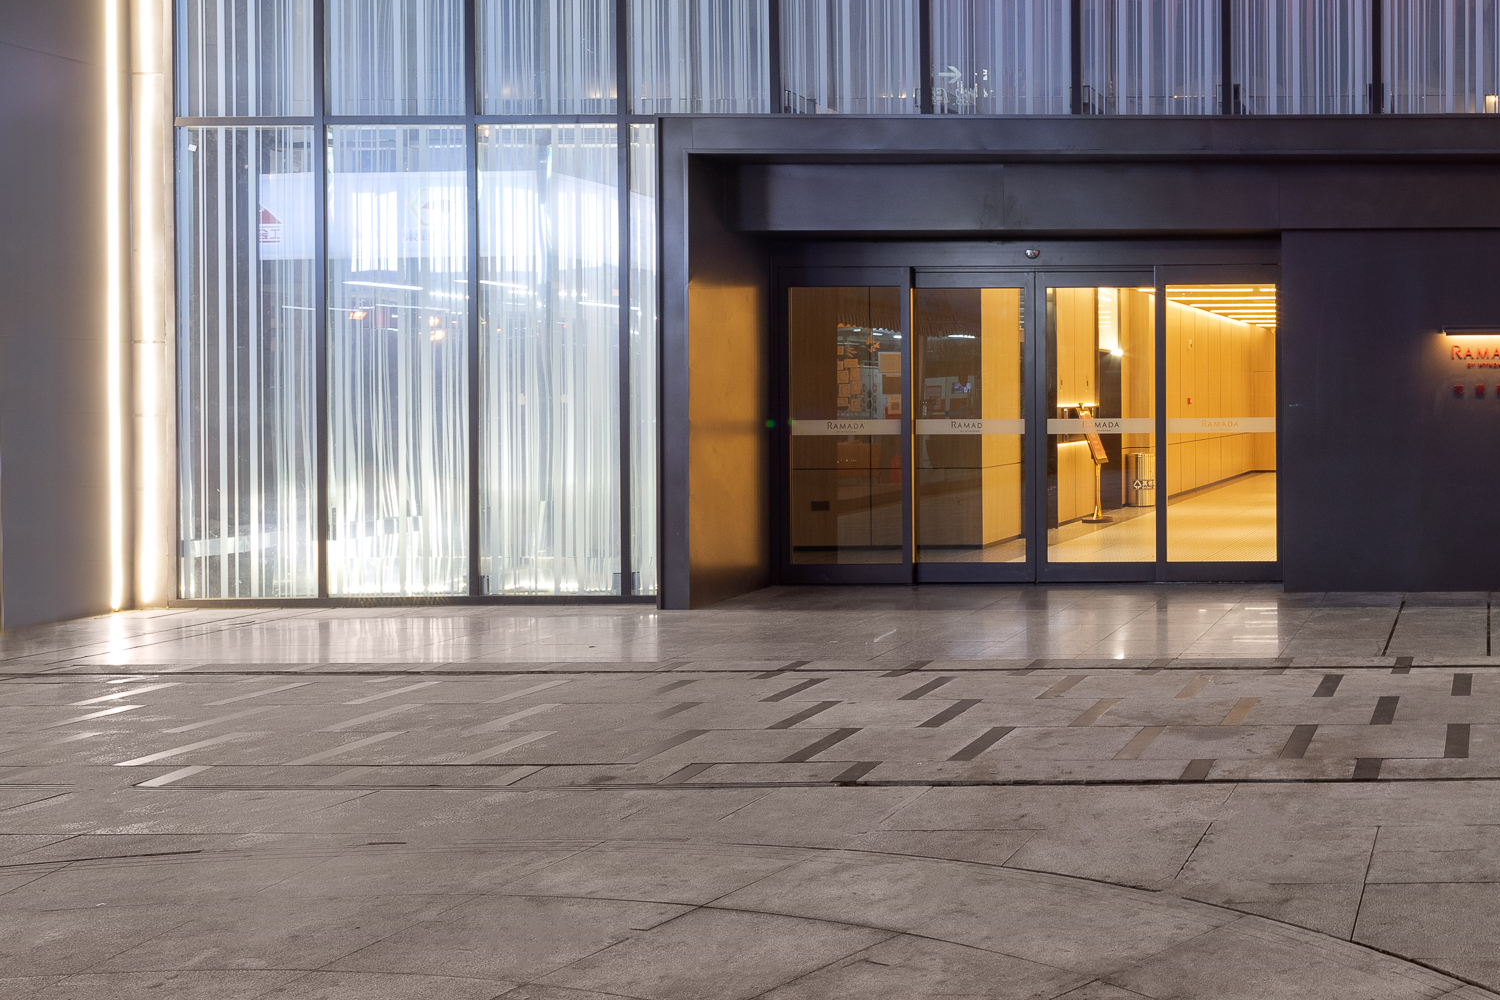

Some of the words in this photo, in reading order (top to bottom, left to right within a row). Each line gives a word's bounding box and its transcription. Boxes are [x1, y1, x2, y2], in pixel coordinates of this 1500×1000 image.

[827, 421, 865, 430] RAMADA
[1081, 420, 1121, 429] RAMADA
[1201, 419, 1240, 428] RAMADA
